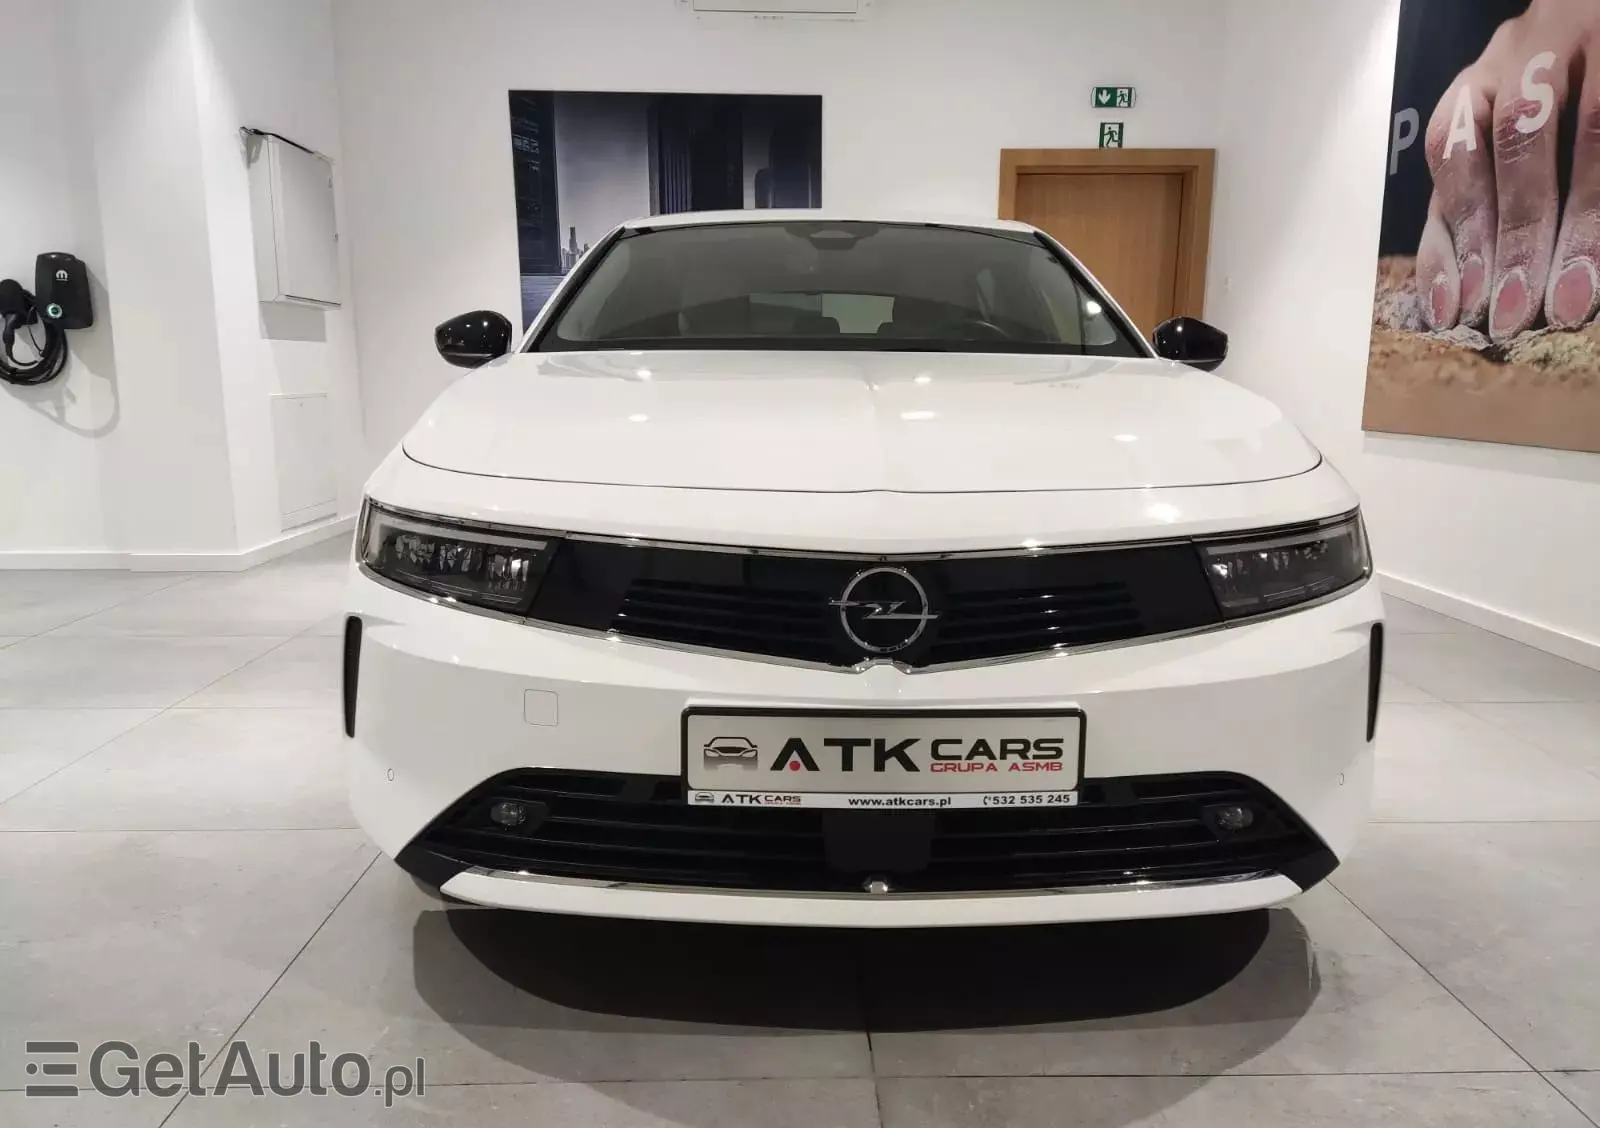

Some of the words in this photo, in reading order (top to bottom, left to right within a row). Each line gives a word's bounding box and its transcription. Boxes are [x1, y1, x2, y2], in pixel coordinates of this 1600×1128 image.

[769, 737, 921, 772] ATK
[930, 737, 1064, 761] CARS
[930, 761, 998, 773] GRUPA
[1008, 761, 1063, 772] ASMB
[721, 794, 761, 804] ATK
[847, 796, 952, 808] www.atkcars.pl
[992, 795, 1016, 805] 532
[1020, 794, 1043, 804] 535
[1047, 794, 1070, 803] 245
